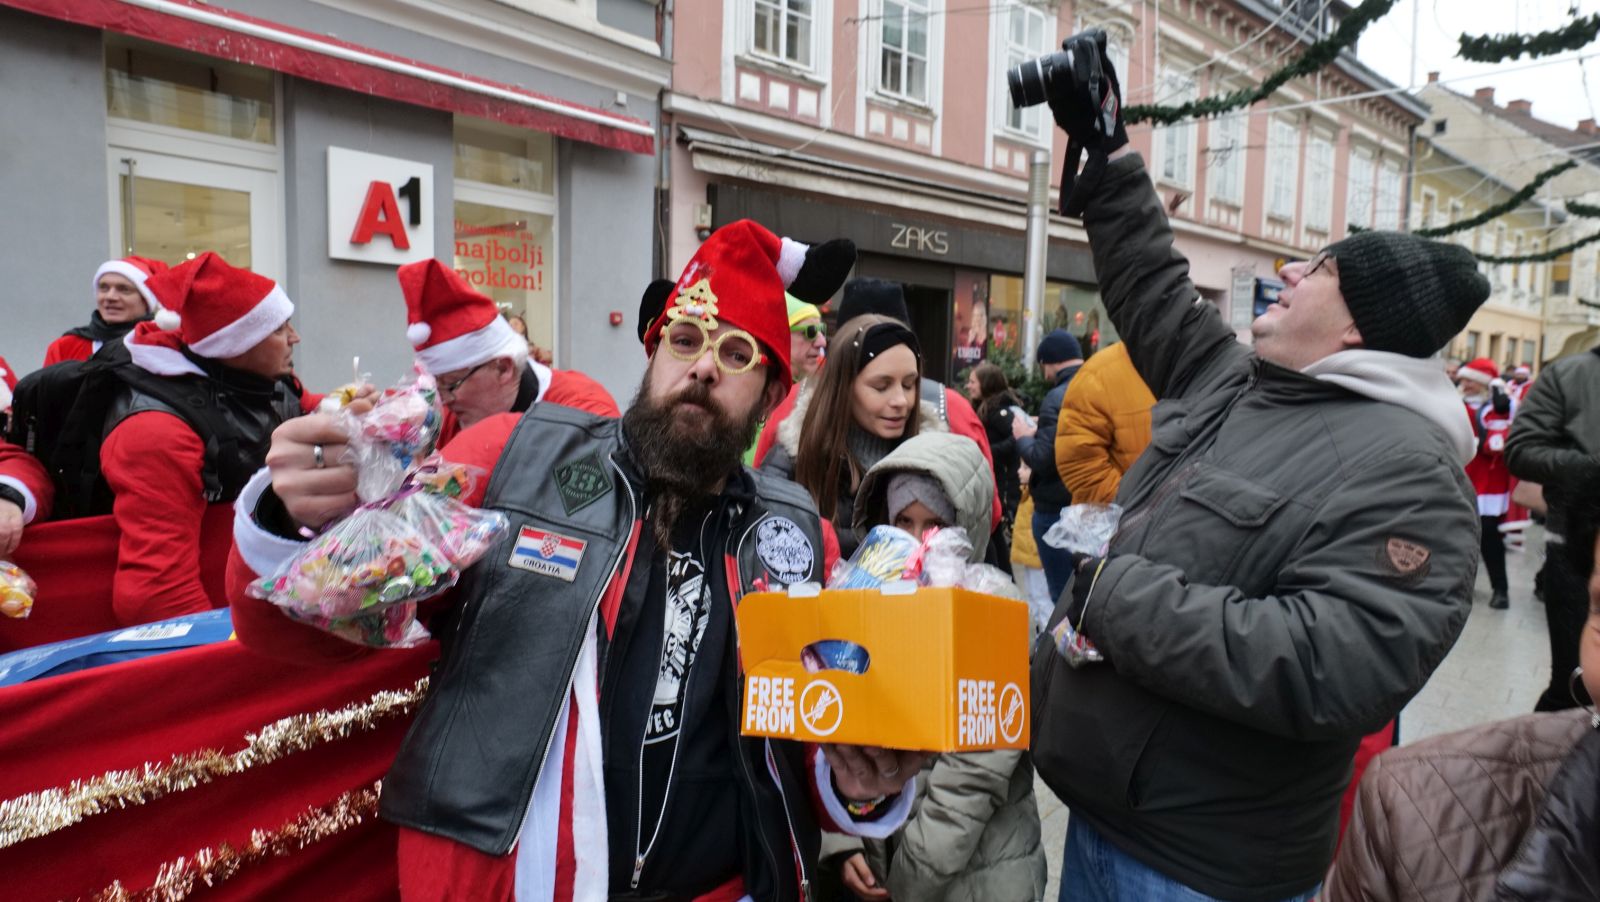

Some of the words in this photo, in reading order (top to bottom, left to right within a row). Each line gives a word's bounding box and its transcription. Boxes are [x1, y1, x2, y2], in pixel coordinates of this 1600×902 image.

[351, 177, 421, 250] A1
[455, 239, 543, 269] najbolji
[891, 223, 949, 255] ZAKS
[523, 559, 561, 575] CROATIA
[748, 676, 795, 707] FREE
[958, 679, 996, 715] FREE
[746, 705, 795, 734] FROM
[958, 714, 996, 746] FROM
